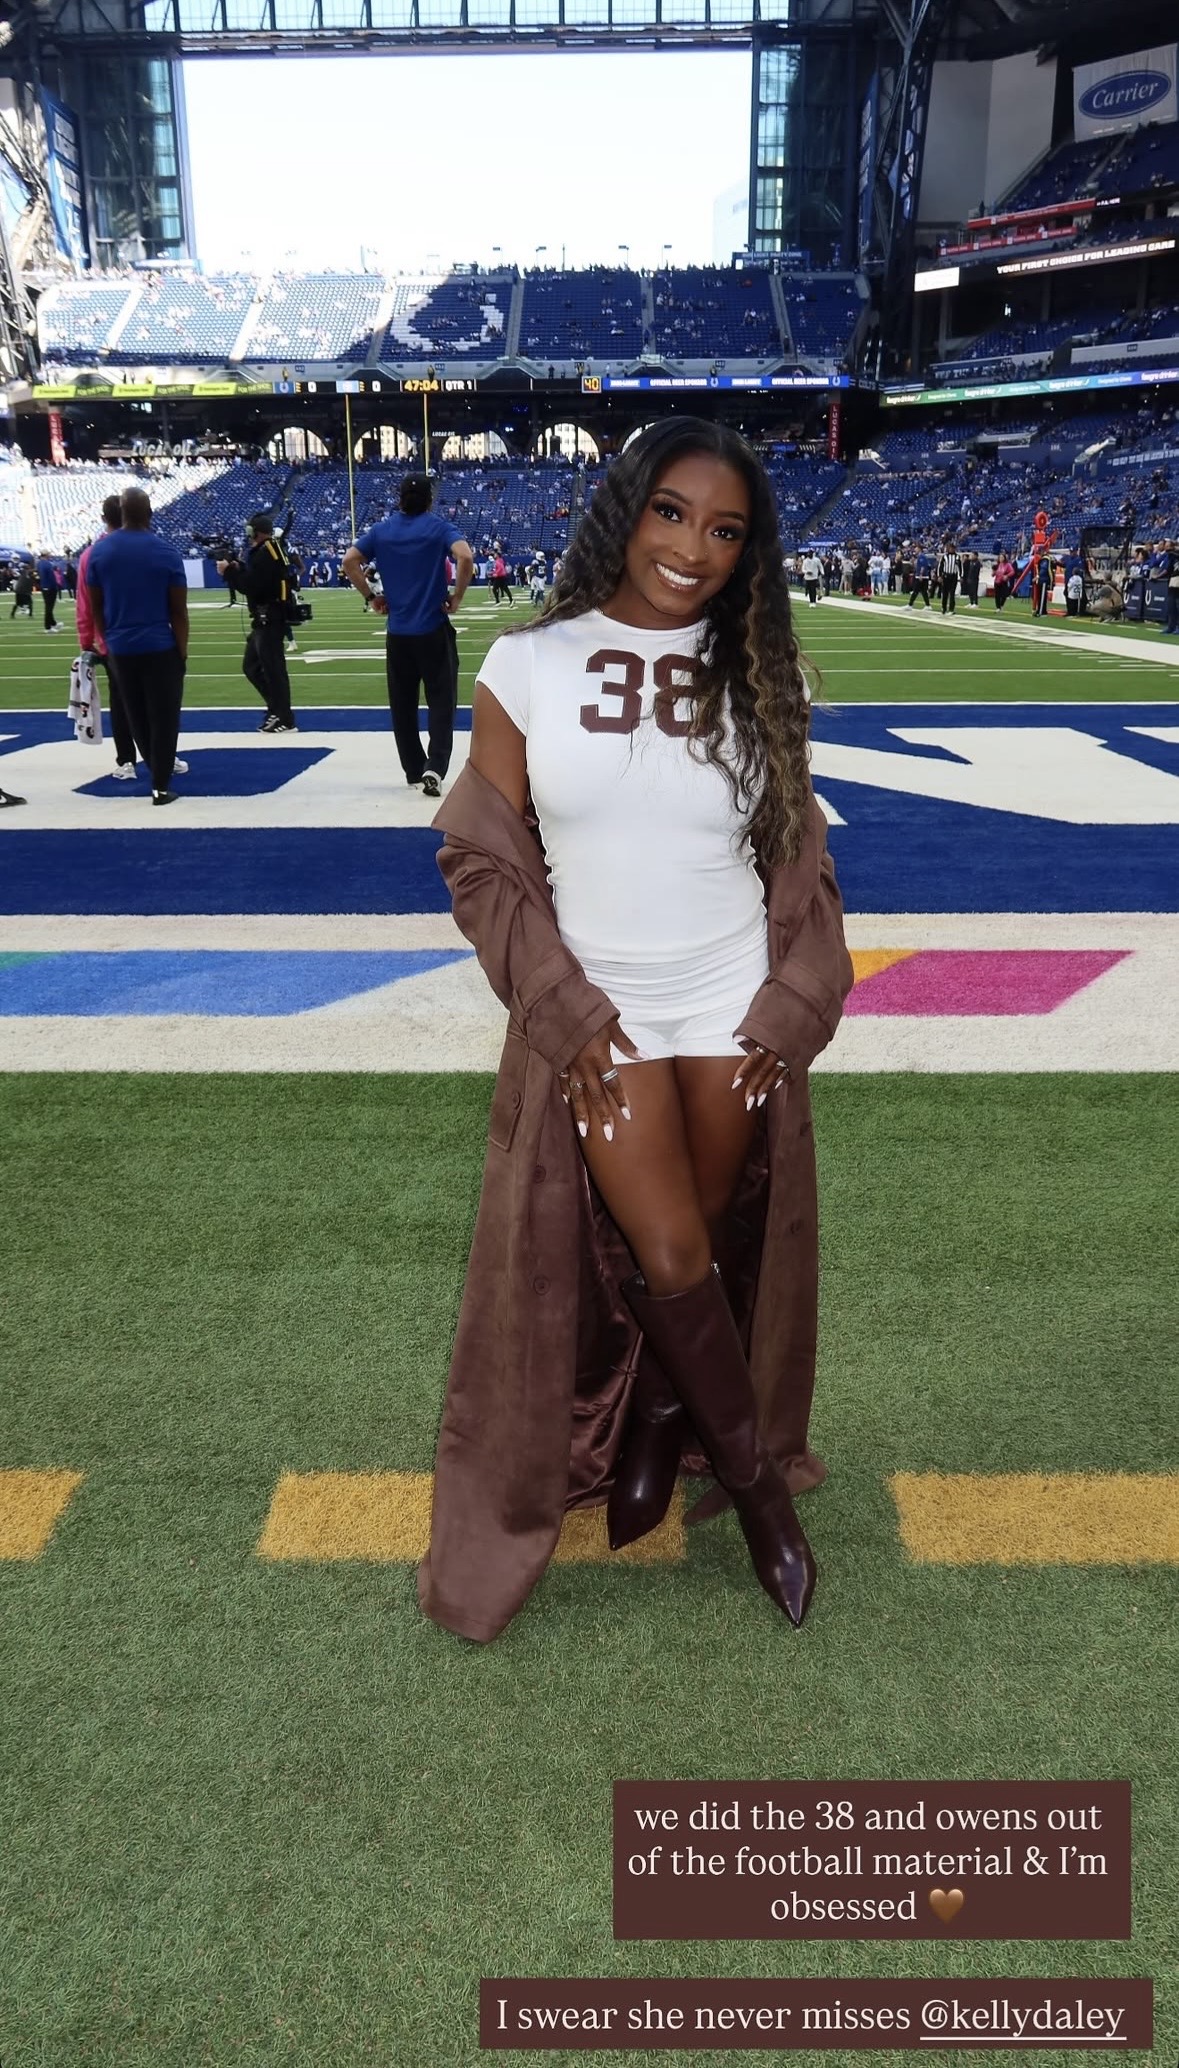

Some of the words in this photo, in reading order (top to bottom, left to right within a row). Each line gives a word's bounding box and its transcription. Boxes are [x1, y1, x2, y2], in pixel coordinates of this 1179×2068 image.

[1092, 82, 1158, 109] Carrier
[997, 262, 1021, 274] YOUR
[1022, 259, 1050, 271] FIRST
[1050, 254, 1084, 267] CHOICE
[1084, 250, 1104, 261] FOR
[1104, 243, 1148, 258] LEADING
[1147, 239, 1176, 252] CARE
[307, 381, 318, 393] 0
[372, 380, 381, 392] 0
[404, 380, 439, 391] 47:04
[445, 380, 465, 391] QTR
[466, 380, 473, 390] 1
[584, 377, 599, 391] 40
[580, 649, 716, 738] 38
